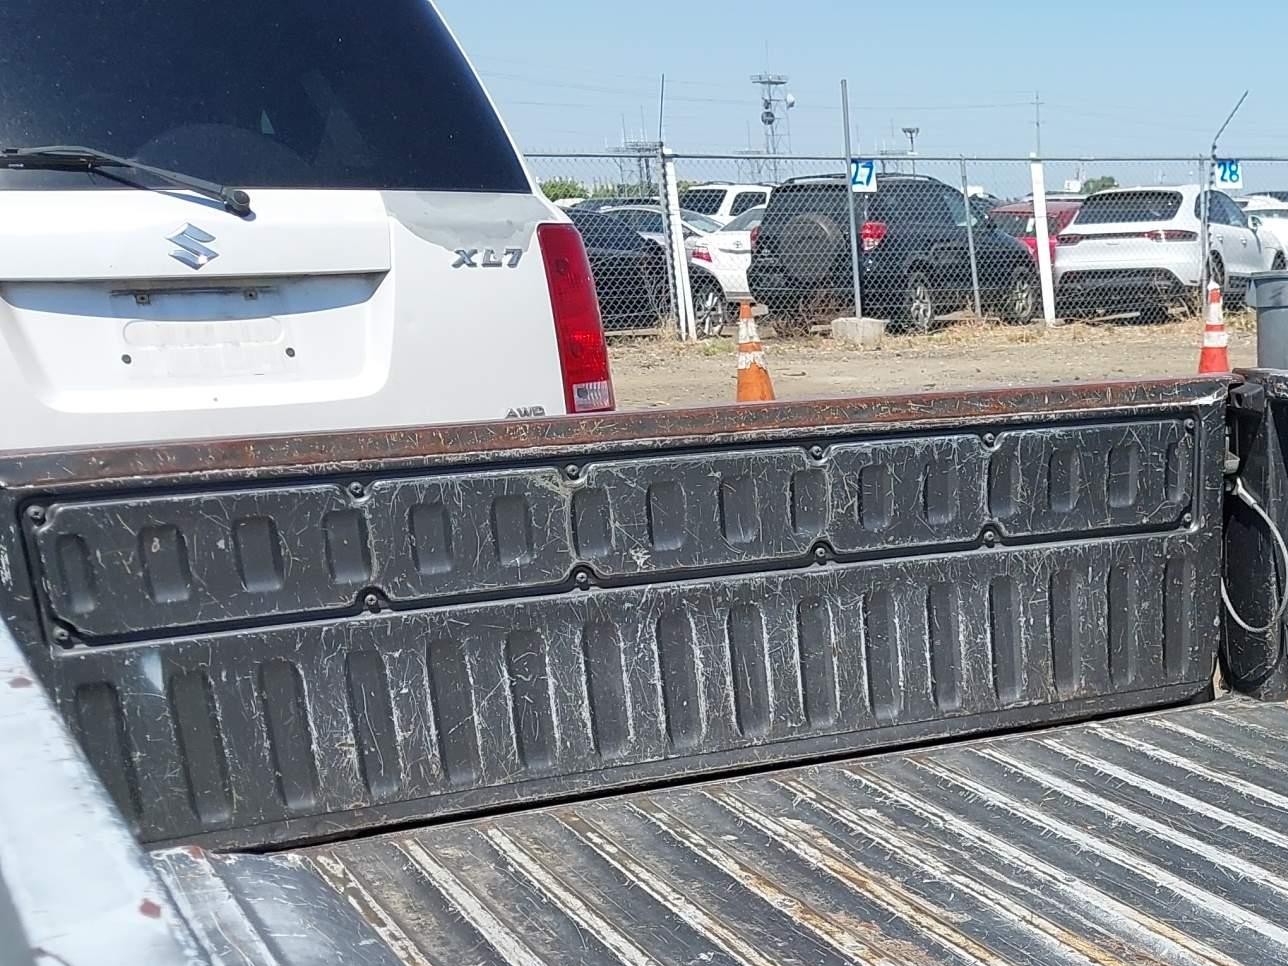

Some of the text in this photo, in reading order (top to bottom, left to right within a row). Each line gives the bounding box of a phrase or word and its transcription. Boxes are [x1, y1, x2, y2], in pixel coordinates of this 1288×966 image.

[851, 159, 873, 186] 27
[1217, 159, 1239, 183] 28
[451, 248, 523, 269] XL7
[505, 405, 546, 419] AWD
